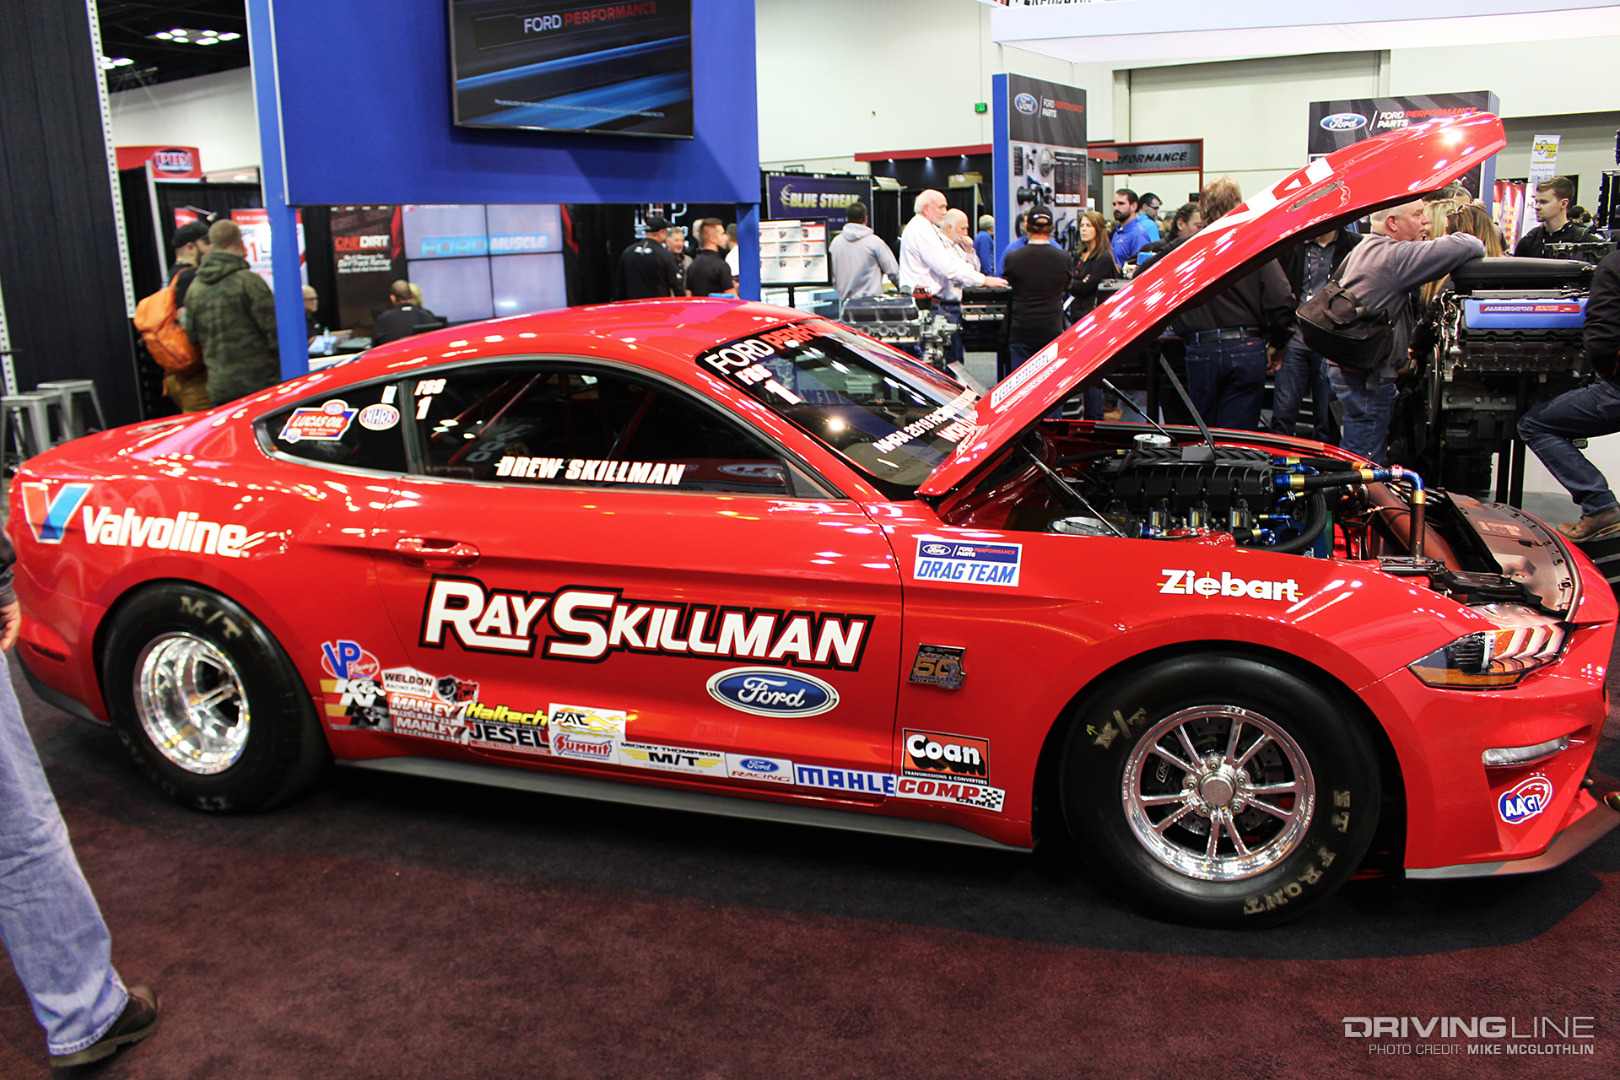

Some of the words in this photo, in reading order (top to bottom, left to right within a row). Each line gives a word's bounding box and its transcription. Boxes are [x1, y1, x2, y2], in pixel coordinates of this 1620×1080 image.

[524, 15, 562, 33] FORD
[564, 2, 657, 26] PERFORMANCE
[1329, 115, 1358, 129] Ford
[1377, 119, 1409, 129] PARTS
[1380, 111, 1404, 120] FORD
[789, 192, 818, 208] BLUE
[421, 236, 487, 256] FORD
[489, 234, 549, 250] MUSCLE
[704, 339, 775, 375] FORD
[764, 378, 803, 406] 1
[365, 409, 394, 425] NHRA
[415, 396, 432, 420] 1
[291, 415, 326, 427] LUCAS
[325, 417, 345, 428] OIL
[871, 430, 914, 454] NHRA
[903, 418, 936, 439] 2019
[496, 456, 563, 479] DREW
[565, 459, 686, 485] SKILLMAN
[82, 505, 248, 557] Valvoline
[917, 560, 966, 579] DRAG
[968, 563, 1016, 583] TEAM
[1158, 569, 1299, 603] Ziebart
[425, 580, 546, 651] RAY
[548, 591, 865, 665] SKILLMAN
[322, 641, 361, 679] VP
[384, 672, 434, 687] WELDON
[738, 677, 805, 708] Ford
[392, 695, 455, 717] MANLEY
[465, 702, 548, 727] Haltech
[396, 716, 460, 736] MANLEY
[552, 711, 590, 727] PAC
[469, 724, 550, 749] JESEL
[621, 742, 659, 751] MICKEY
[661, 746, 720, 757] THOMPSON
[648, 751, 699, 766] M/T
[906, 734, 981, 765] Coan
[731, 770, 791, 782] RACING
[747, 760, 772, 772] Ford
[797, 766, 895, 794] MAHLE
[904, 770, 947, 780] TRANSMISSIONS
[954, 775, 988, 785] CONVERTERS
[898, 778, 980, 800] COMP
[956, 797, 996, 809] CAMS
[1504, 795, 1541, 817] AAGI
[1243, 848, 1337, 916] FRONT
